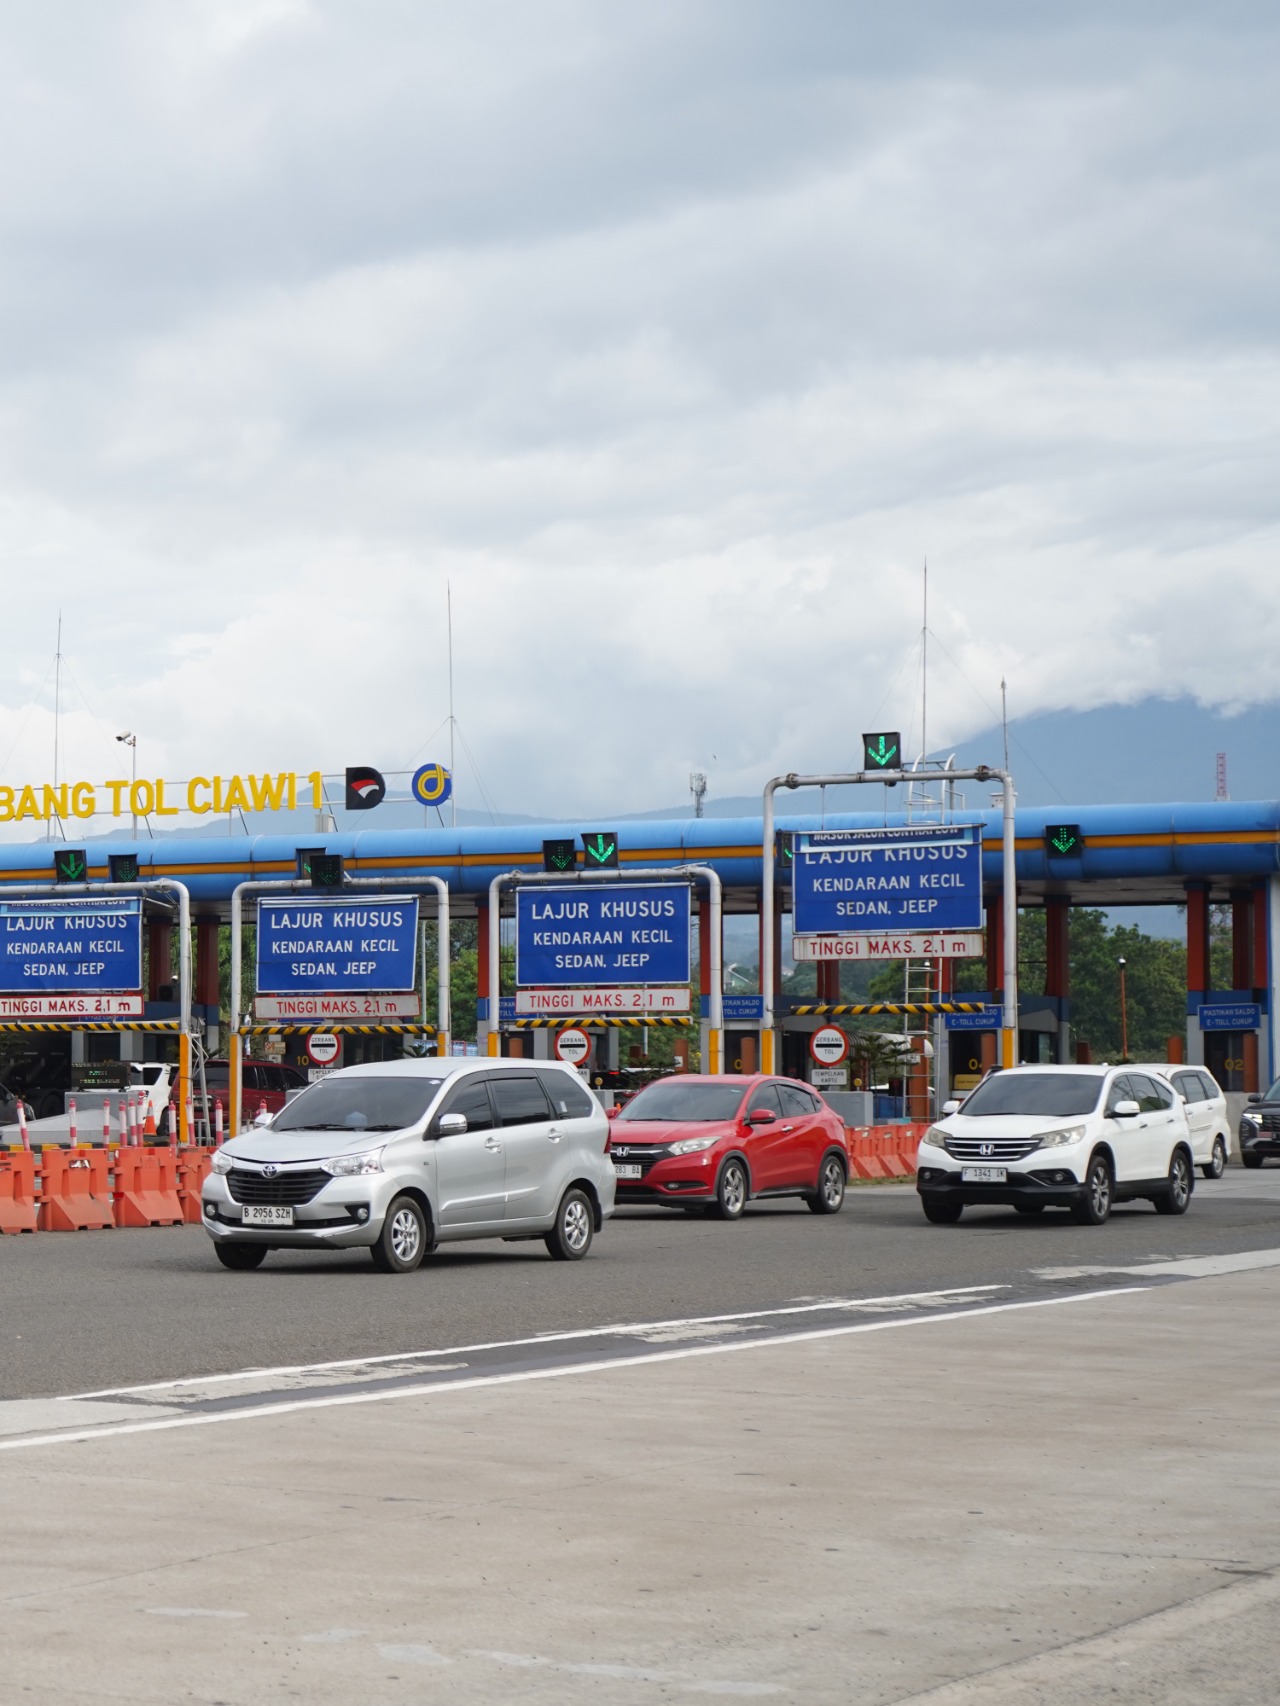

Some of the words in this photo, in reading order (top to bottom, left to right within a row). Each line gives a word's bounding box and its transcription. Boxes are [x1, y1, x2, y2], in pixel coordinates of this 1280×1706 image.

[105, 778, 179, 817] TOL
[187, 772, 296, 814] CIAWI
[308, 771, 322, 809] 1
[805, 849, 873, 865] LAJUR
[884, 846, 968, 862] KHUSUS
[813, 875, 910, 892] KENDARAAN
[920, 874, 965, 888] KECIL
[532, 903, 589, 920] LAJUR
[601, 900, 675, 918] KHUSUS
[836, 901, 891, 915] SEDAN,
[898, 899, 938, 914] JEEP
[6, 916, 54, 931] LAJUR
[65, 915, 127, 930] KHUSUS
[271, 913, 323, 929] LAJUR
[333, 911, 403, 928] KHUSUS
[533, 931, 622, 946] KENDARAAN
[631, 930, 673, 943] KECIL
[7, 942, 82, 955] KENDARAAN
[89, 940, 124, 953] KECIL
[272, 940, 353, 954] KENDARAAN
[361, 939, 399, 952] KECIL
[810, 941, 859, 955] TINGGI
[868, 940, 916, 954] MAKS.
[952, 942, 966, 952] m
[555, 954, 607, 968] SEDAN,
[613, 954, 650, 967] JEEP
[23, 963, 69, 976] SEDAN,
[74, 962, 105, 975] JEEP
[291, 962, 337, 976] SEDAN,
[343, 962, 377, 975] JEEP
[1, 1001, 42, 1013] TINGGI
[48, 1000, 88, 1012] MAKS.
[118, 1001, 131, 1011] m
[276, 1001, 317, 1014] TINGGI
[322, 1002, 360, 1013] MAKS.
[385, 1003, 397, 1012] m
[529, 995, 574, 1008] TINGGI
[583, 994, 626, 1007] MAKS.
[662, 996, 675, 1006] m
[297, 1055, 309, 1066] 10
[1224, 1058, 1244, 1071] 02
[244, 1207, 250, 1218] B
[275, 1208, 291, 1219] SZH
